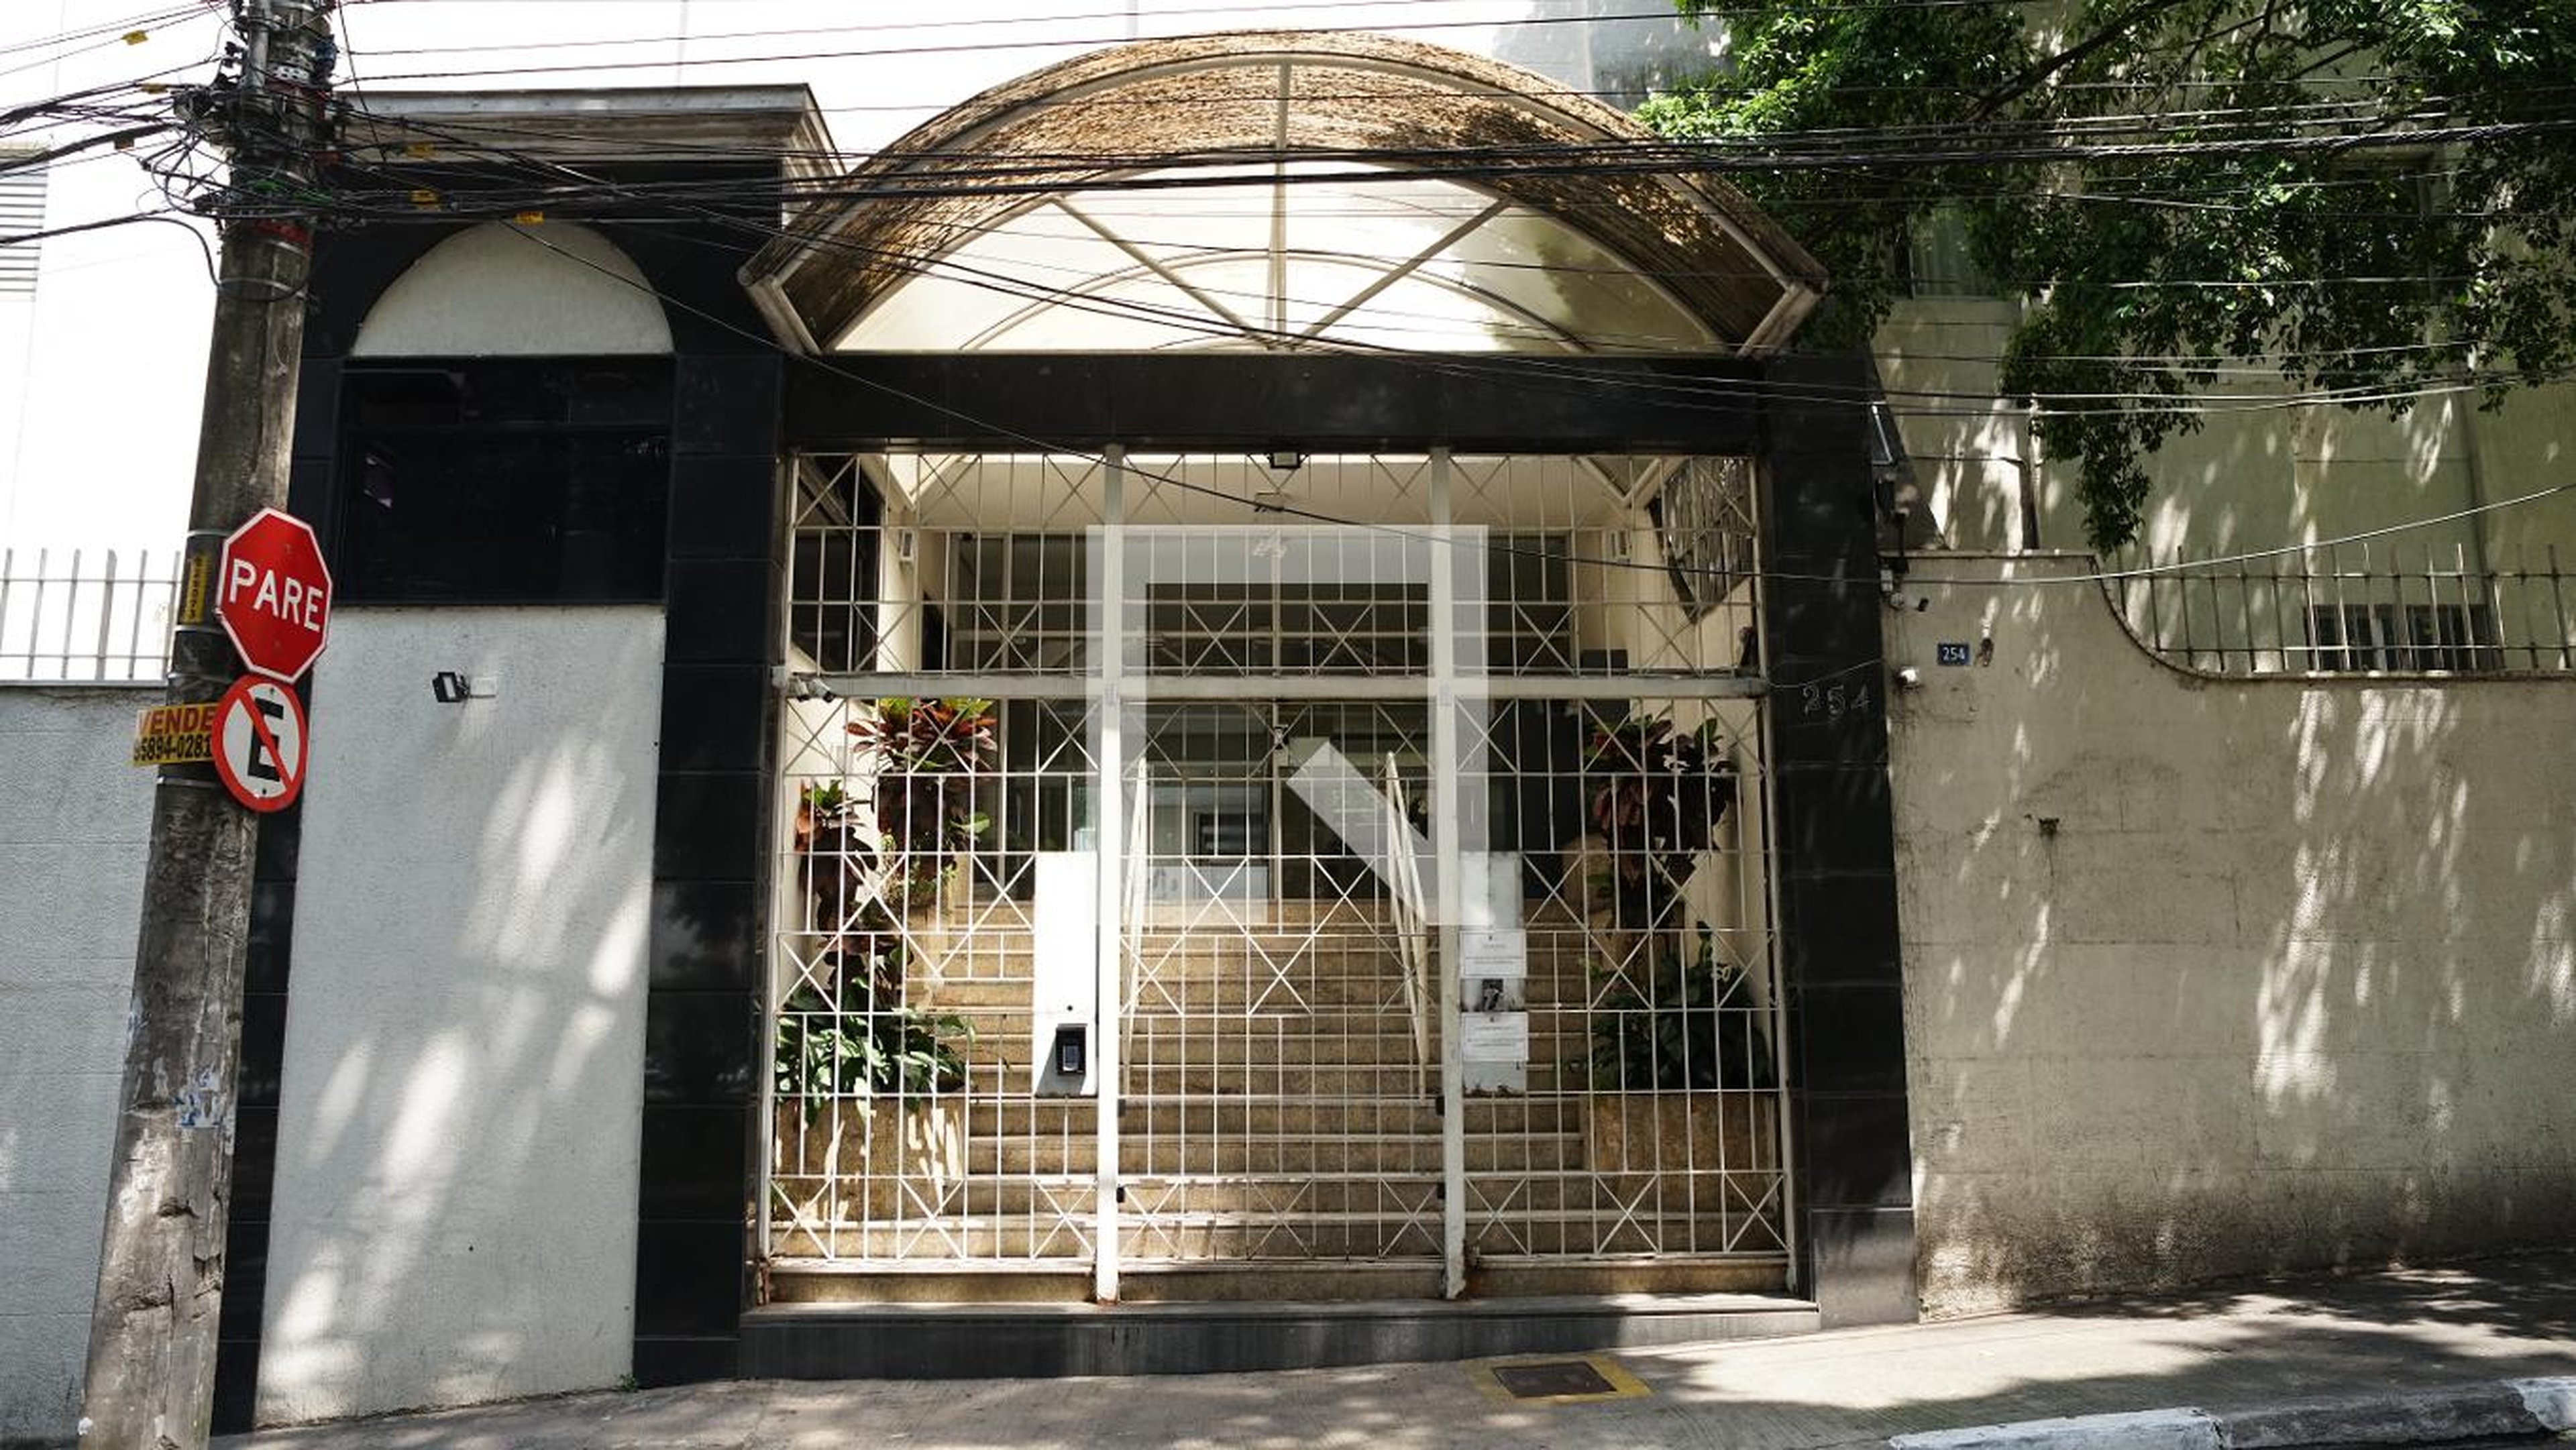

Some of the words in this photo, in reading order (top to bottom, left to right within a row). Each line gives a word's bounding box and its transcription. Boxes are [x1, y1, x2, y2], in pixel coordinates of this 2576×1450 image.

[229, 558, 323, 632] PARE
[1942, 646, 1966, 661] 254
[1803, 682, 1870, 715] 254
[248, 697, 284, 783] E
